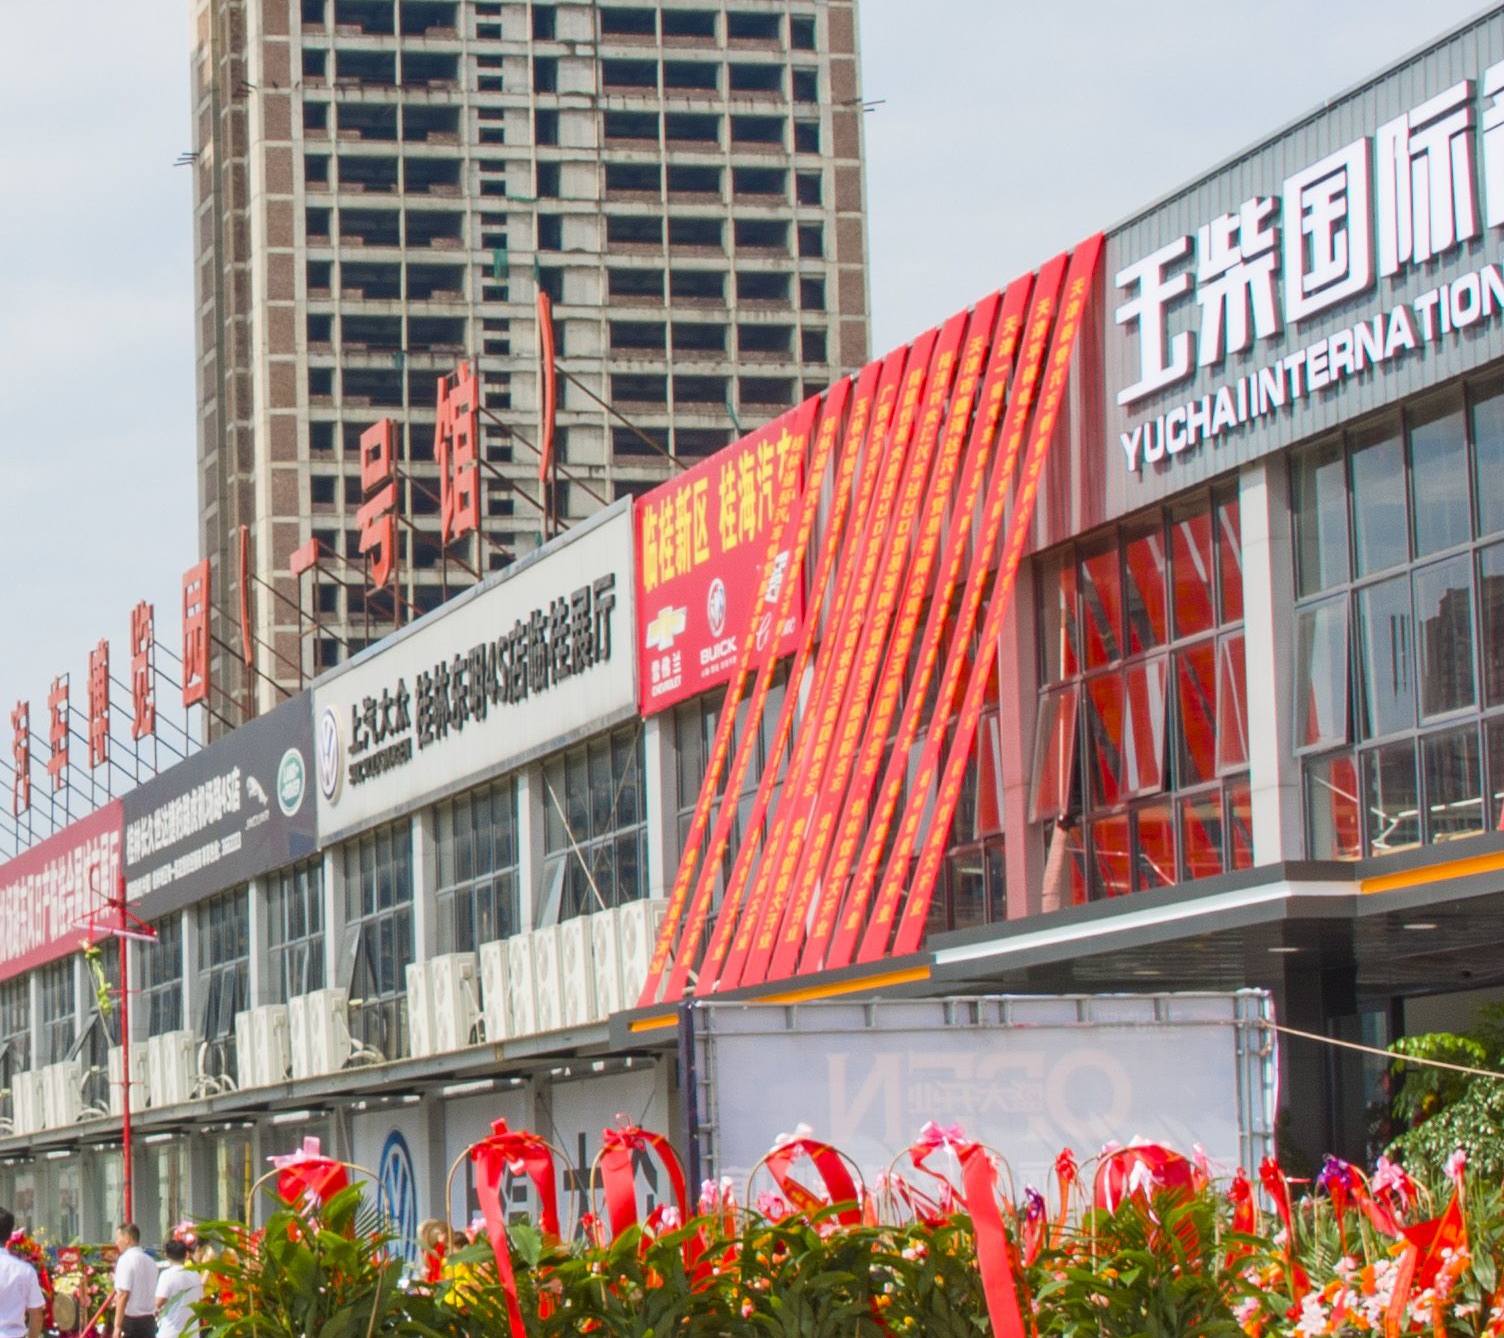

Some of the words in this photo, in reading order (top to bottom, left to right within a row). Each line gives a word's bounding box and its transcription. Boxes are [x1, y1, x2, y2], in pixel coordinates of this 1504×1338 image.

[1120, 388, 1248, 472] YUCHAI
[643, 477, 710, 594] 临桂新区
[700, 634, 738, 667] BUICK
